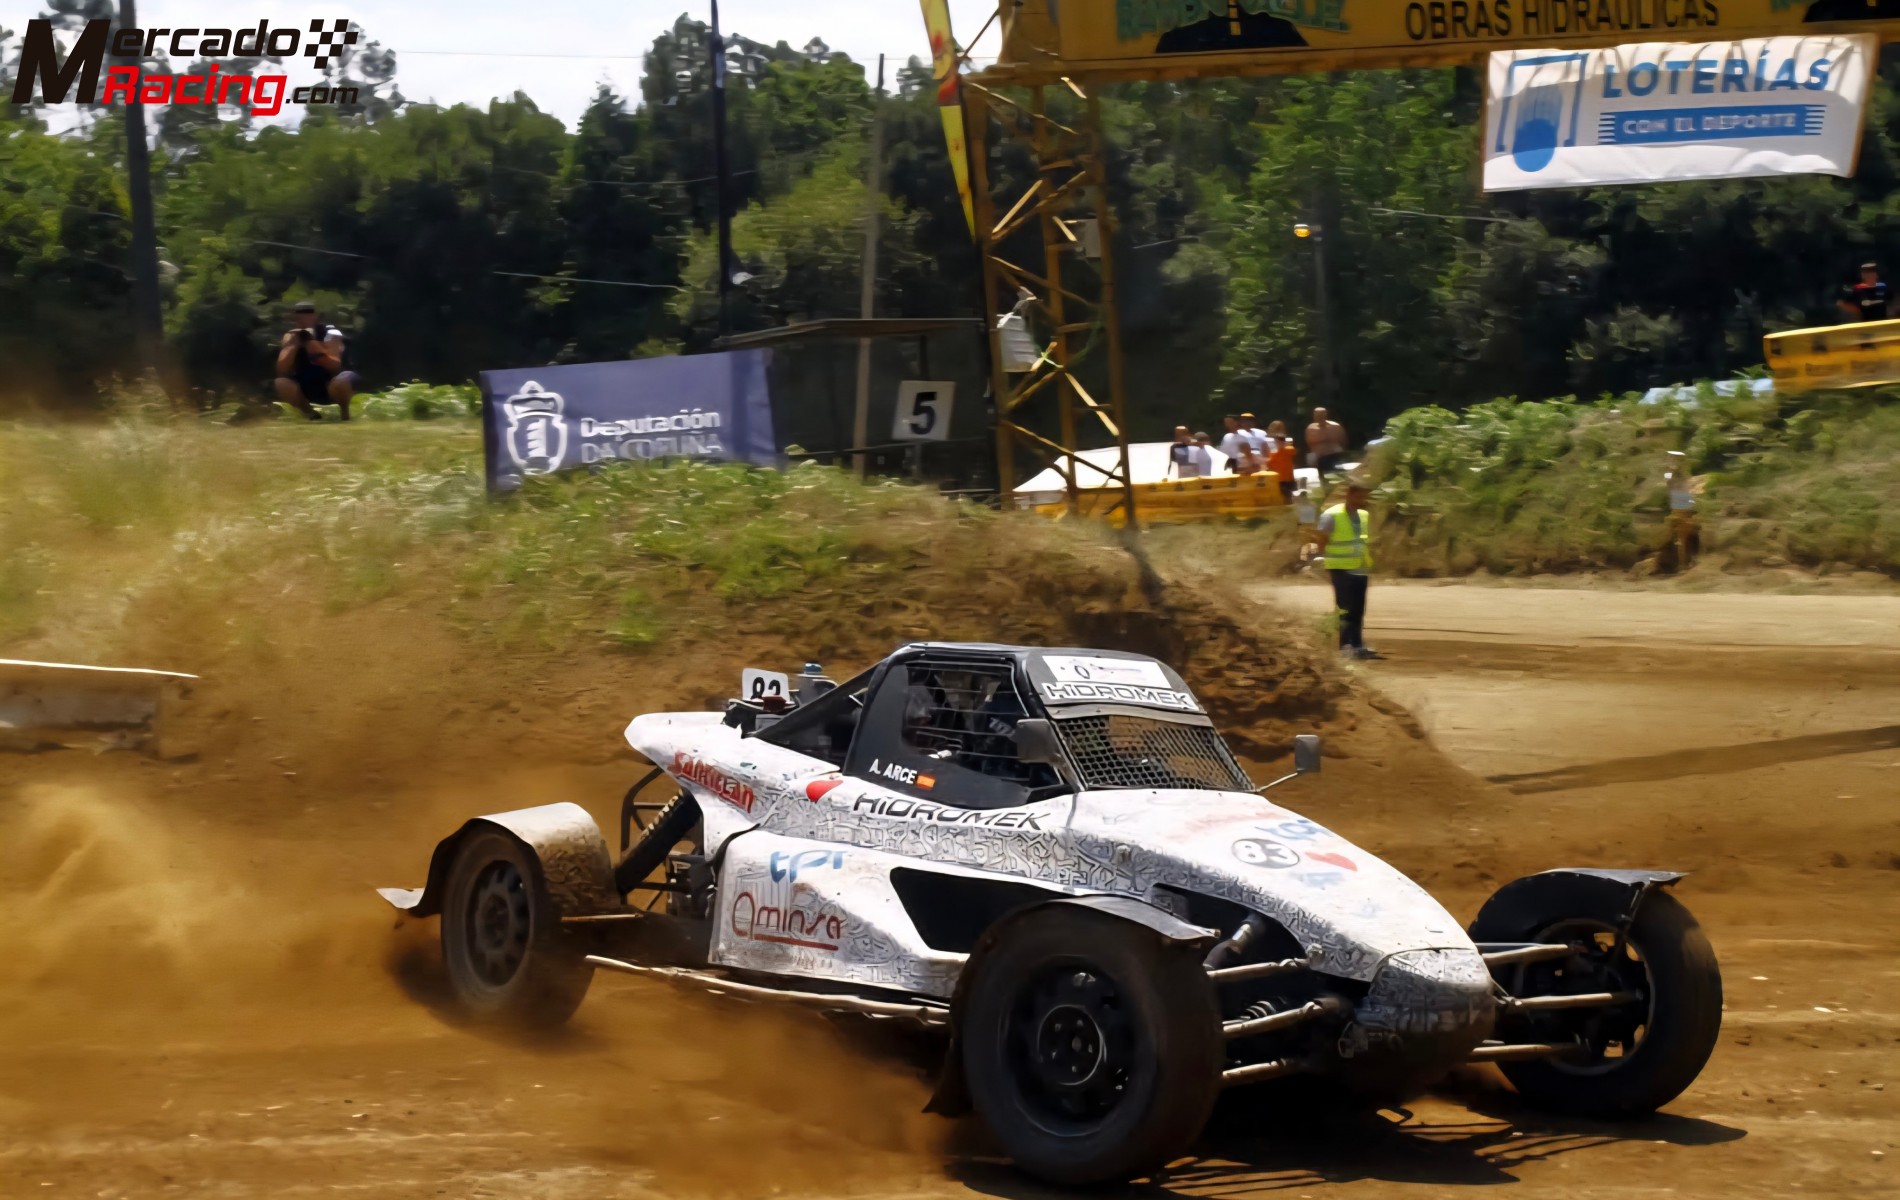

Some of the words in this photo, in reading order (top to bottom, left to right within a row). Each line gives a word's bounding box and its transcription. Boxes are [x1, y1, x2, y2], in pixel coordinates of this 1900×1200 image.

[1405, 2, 1512, 40] OBRAS
[1602, 49, 1830, 98] LOTERÍAS
[580, 408, 721, 441] Deputación
[909, 391, 937, 435] 5
[883, 762, 918, 785] ARCE
